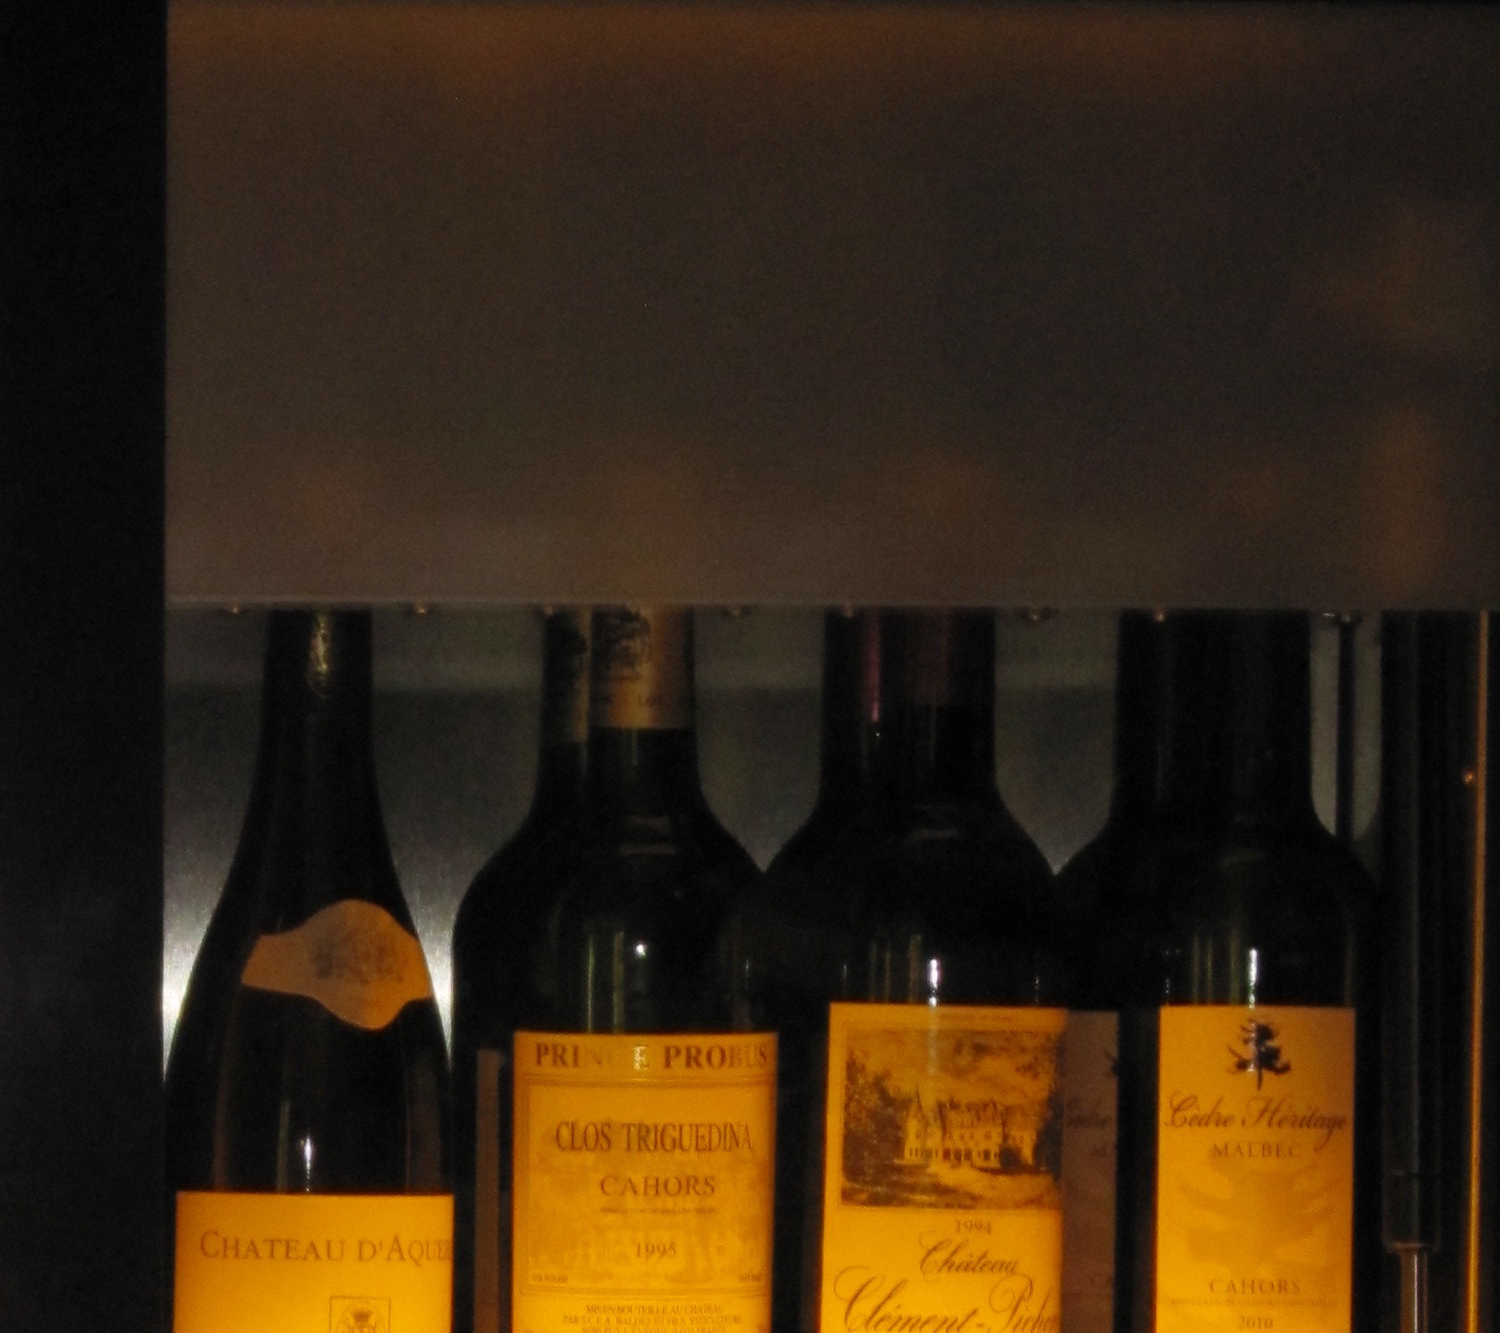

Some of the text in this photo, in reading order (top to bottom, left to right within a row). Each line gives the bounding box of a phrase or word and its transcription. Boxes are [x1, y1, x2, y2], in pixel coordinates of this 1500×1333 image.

[664, 1042, 768, 1070] PROBUS
[555, 1120, 754, 1153] CLOS TRIGUEDINA
[1212, 1142, 1302, 1158] MALBEC
[599, 1174, 716, 1197] CAHORS
[955, 1219, 992, 1235] 1994
[200, 1230, 345, 1262] CHATEAU
[1209, 1277, 1302, 1296] CAHORS
